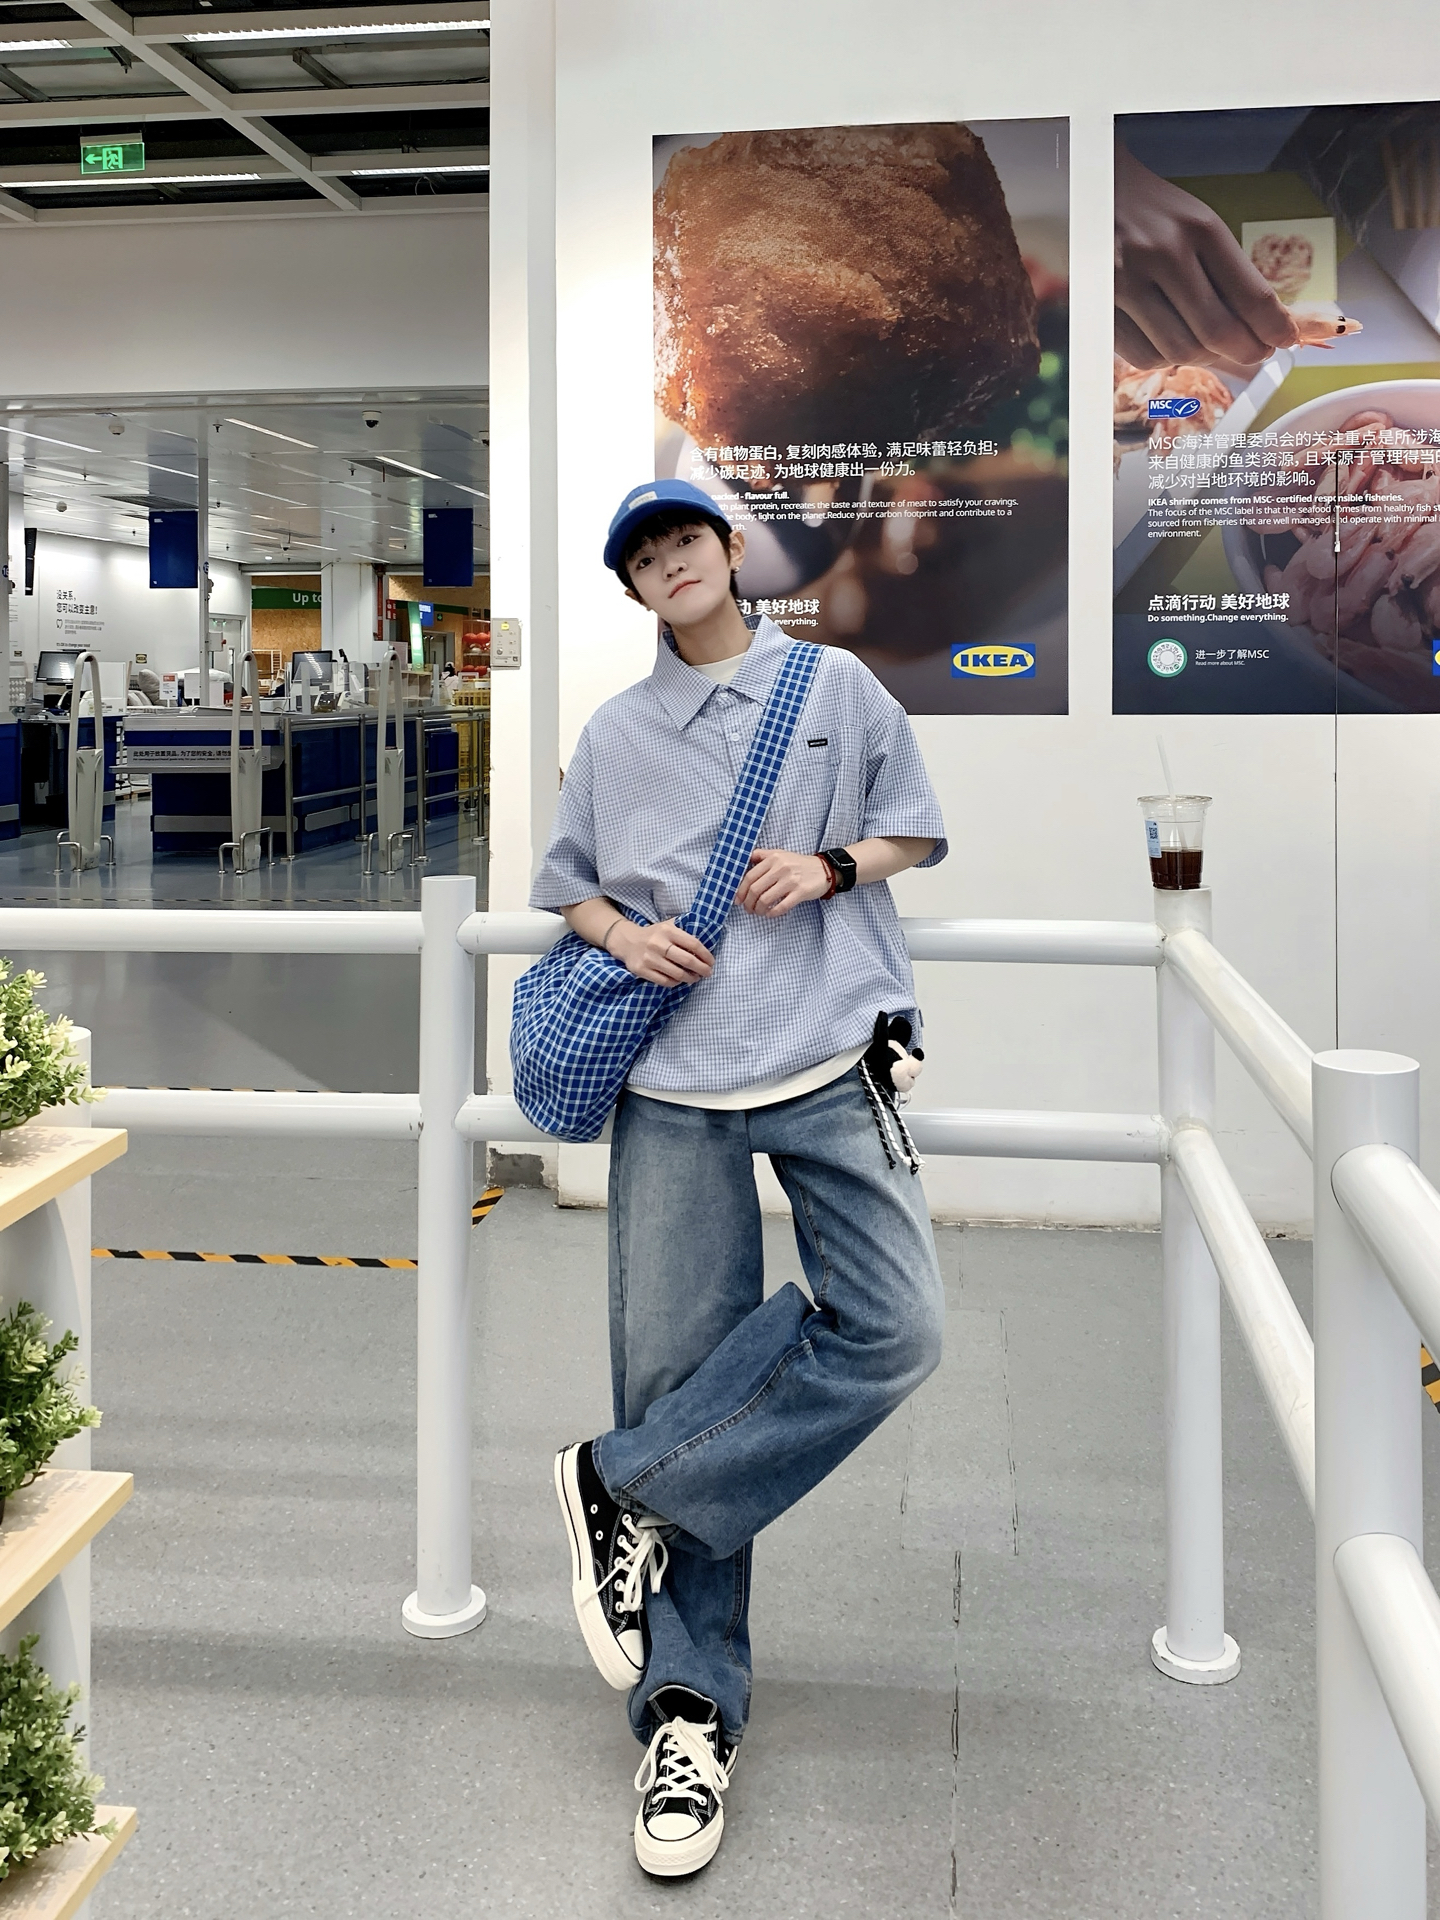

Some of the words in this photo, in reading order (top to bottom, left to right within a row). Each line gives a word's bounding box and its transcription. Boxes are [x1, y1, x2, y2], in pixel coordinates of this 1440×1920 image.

[1150, 400, 1172, 409] MSC
[1148, 470, 1316, 489] 减少对当地环境的影响。
[744, 492, 773, 500] flavour
[774, 491, 790, 499] full.
[1148, 498, 1167, 506] IKEA
[1169, 497, 1199, 507] shrimp
[1230, 496, 1251, 504] from
[1277, 494, 1312, 503] certified
[1365, 493, 1404, 502] fisheries.
[730, 503, 749, 511] plant
[751, 502, 779, 511] protein,
[851, 500, 866, 508] and
[868, 500, 895, 508] texture
[898, 499, 906, 507] of
[928, 499, 936, 507] to
[938, 498, 963, 508] satisfy
[965, 499, 983, 508] your
[984, 498, 1018, 507] cravings.
[1148, 508, 1163, 516] The
[1165, 508, 1187, 516] focus
[1189, 507, 1197, 516] of
[1199, 507, 1213, 516] the
[1214, 507, 1233, 515] MSC
[1234, 506, 1254, 515] label
[1256, 506, 1262, 514] is
[1264, 506, 1281, 514] that
[1283, 505, 1296, 513] the
[1298, 505, 1331, 513] seafood
[1362, 504, 1381, 512] from
[1384, 503, 1414, 514] healthy
[1416, 503, 1431, 511] fish
[758, 512, 775, 522] light
[788, 512, 800, 520] the
[856, 510, 874, 519] your
[875, 509, 903, 517] carbon
[904, 508, 938, 519] footprint
[939, 509, 954, 517] and
[955, 508, 995, 517] contribute
[1148, 519, 1180, 528] sourced
[1181, 518, 1201, 527] from
[1203, 517, 1237, 526] fisheries
[1239, 517, 1256, 525] that
[1272, 516, 1290, 525] well
[1291, 516, 1330, 526] managed
[1349, 515, 1381, 525] operate
[1383, 514, 1401, 523] with
[1403, 514, 1436, 522] minimal
[1148, 529, 1201, 538] environment.
[292, 593, 309, 605] Up
[1148, 594, 1216, 611] 点滴行动
[1221, 593, 1290, 610] 美好地球
[755, 598, 820, 615] 美好地球
[774, 618, 818, 627] everything.
[1148, 614, 1159, 622] Do
[1240, 613, 1288, 623] everything.
[961, 654, 1028, 667] IKEA
[1195, 649, 1270, 660] 进一步了解MSC
